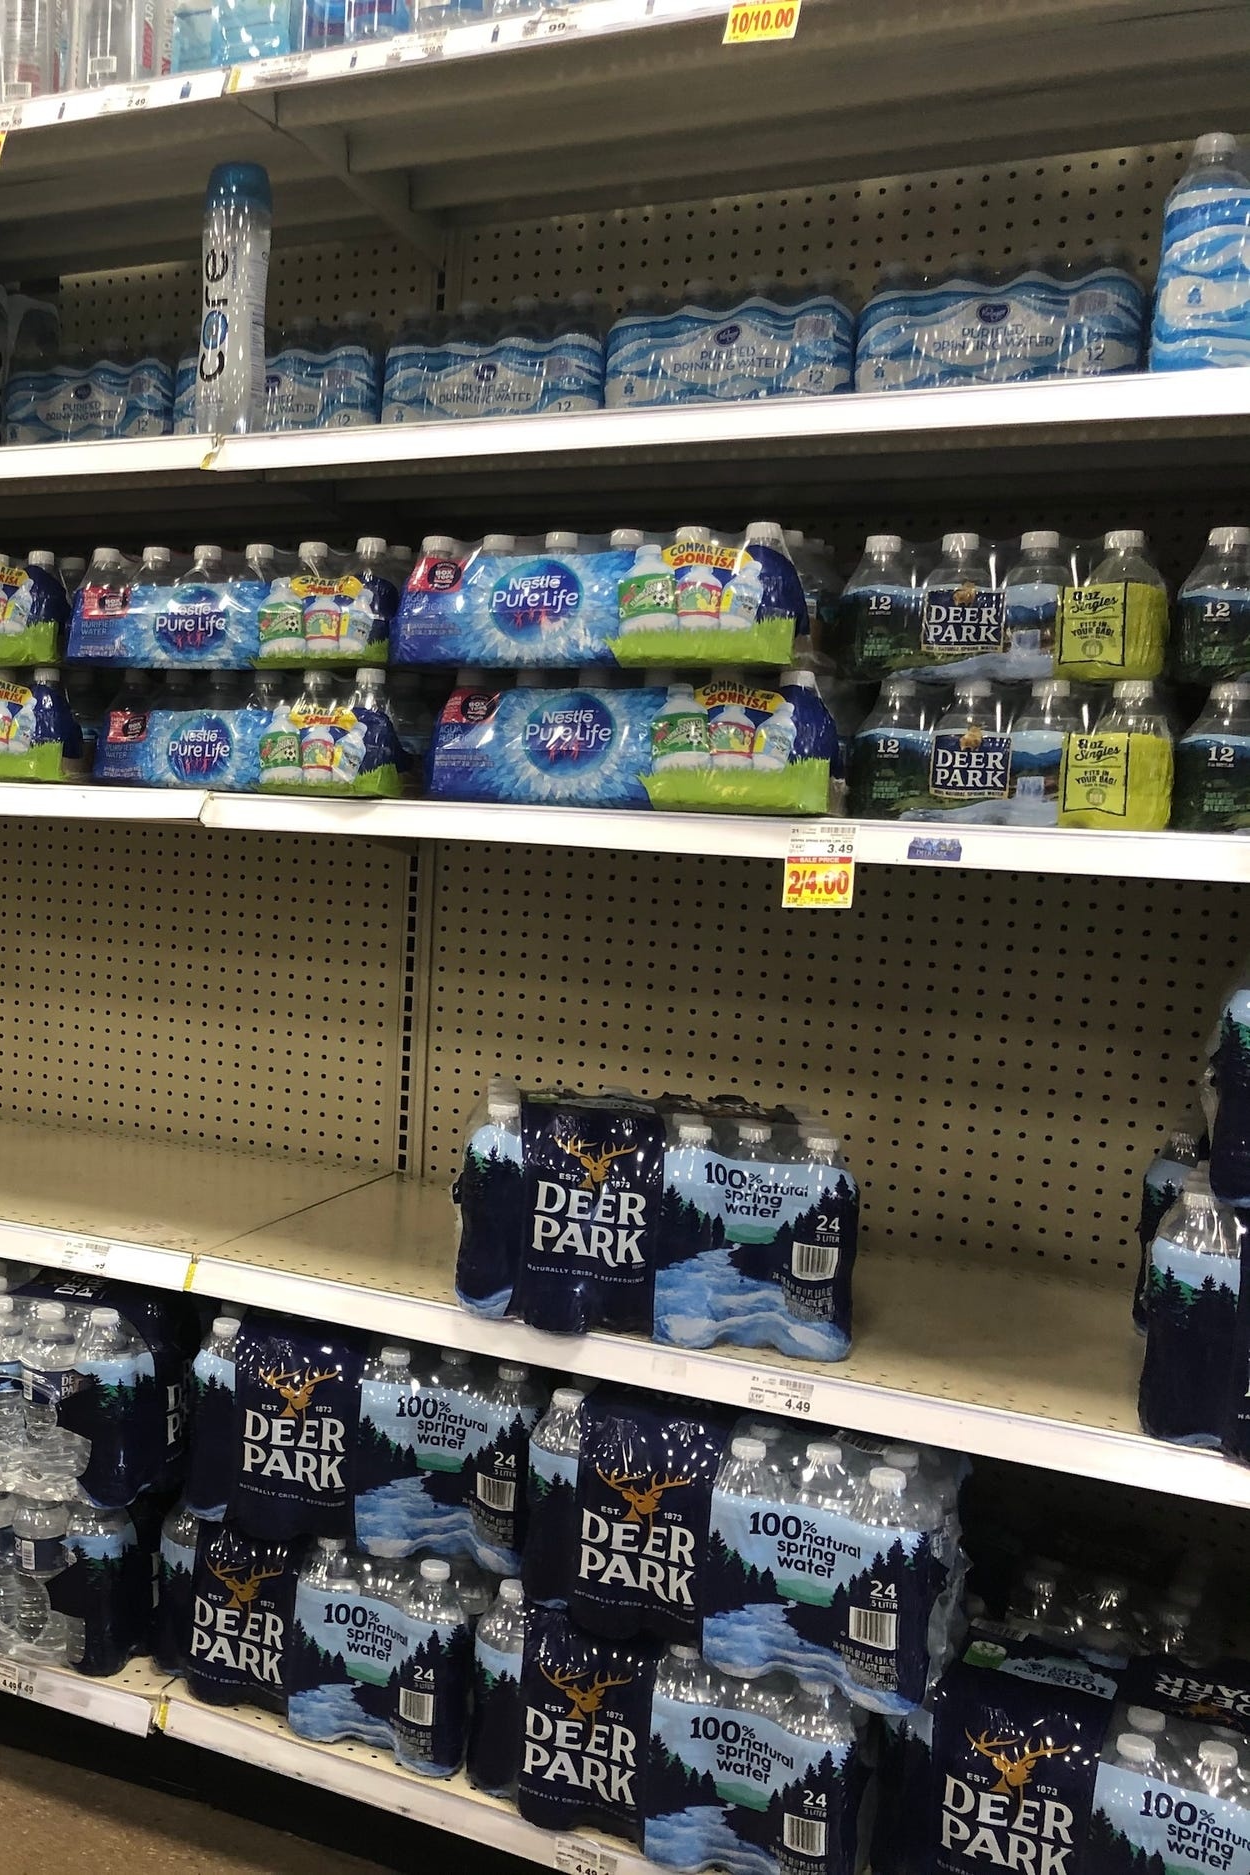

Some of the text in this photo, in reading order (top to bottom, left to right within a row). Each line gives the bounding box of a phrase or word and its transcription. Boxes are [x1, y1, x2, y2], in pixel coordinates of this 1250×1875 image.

[730, 9, 794, 34] 10/10.00
[200, 248, 231, 382] core
[962, 324, 1025, 338] PURIFIED
[932, 335, 1054, 351] DRINKING WATER
[1086, 346, 1105, 361] 12
[699, 347, 757, 361] PURIFIED
[673, 357, 783, 373] DRINKING WATER
[807, 369, 824, 385] 12
[493, 391, 533, 403] WATER
[557, 401, 572, 413] 12
[137, 420, 149, 432] 12
[337, 415, 351, 427] 12
[670, 543, 726, 557] COMPARTE
[672, 553, 735, 568] SONRISA
[492, 589, 579, 613] Pure Life
[869, 595, 892, 610] 12
[1072, 597, 1118, 614] Singles
[1204, 602, 1231, 618] 12
[929, 605, 999, 625] DEER
[1080, 621, 1097, 629] FITS
[155, 616, 226, 637] Pure Life
[927, 625, 999, 643] PARK
[1071, 627, 1094, 637] YOUR
[703, 681, 756, 697] COMPARTE
[705, 693, 768, 710] SONRISA
[525, 724, 612, 748] Pure Life
[877, 739, 899, 753] 12
[169, 742, 230, 763] Pure Life
[935, 748, 1005, 769] DEER
[1075, 747, 1121, 762] Singles
[1208, 746, 1235, 762] 12
[935, 768, 1005, 788] PARK
[1075, 775, 1117, 786] YOUR BAG!
[827, 843, 854, 854] 3.49
[788, 870, 849, 897] 2/4.00
[559, 1173, 579, 1182] EST.
[705, 1162, 762, 1190] 100%
[724, 1187, 783, 1208] spring
[748, 1181, 809, 1199] natural
[534, 1180, 647, 1227] DEER
[726, 1202, 781, 1219] water
[815, 1214, 841, 1232] 24
[532, 1214, 646, 1269] PARK
[823, 1234, 840, 1243] LITER
[527, 1263, 645, 1284] NATURALLY CRISP REFRESHING
[261, 1403, 332, 1414] EST. 1873
[395, 1395, 451, 1420] 100%
[784, 1399, 811, 1413] 4.49
[242, 1408, 347, 1454] DEER
[417, 1419, 466, 1442] spring
[438, 1410, 488, 1434] natural
[417, 1431, 465, 1451] water
[242, 1442, 346, 1492] PARK
[493, 1451, 517, 1468] 24
[239, 1482, 276, 1498] NATURALLY
[306, 1497, 346, 1508] REFRESHING
[601, 1505, 683, 1522] EST. 1873
[750, 1511, 817, 1539] 100%
[581, 1507, 696, 1568] DEER
[802, 1531, 861, 1560] natural
[777, 1538, 836, 1568] spring
[578, 1543, 696, 1605] PARK
[777, 1556, 834, 1580] water
[208, 1592, 224, 1602] EST.
[869, 1580, 896, 1600] 24
[194, 1595, 284, 1650] DEER
[323, 1602, 380, 1628] 100%
[346, 1626, 393, 1652] spring
[367, 1620, 408, 1647] natural
[190, 1626, 283, 1685] PARK
[347, 1640, 392, 1663] water
[413, 1665, 435, 1681] 24
[544, 1703, 624, 1721] EST. 1873
[525, 1705, 637, 1768] DEER
[689, 1715, 756, 1742] 100%
[716, 1741, 772, 1773] spring
[741, 1736, 795, 1770] natural
[522, 1743, 636, 1806] PARK
[717, 1759, 771, 1785] water
[966, 1772, 1058, 1796] EST. 1873
[803, 1790, 827, 1808] 24
[942, 1773, 1076, 1845] DEER
[1139, 1789, 1216, 1827] 100%
[940, 1809, 1074, 1875] PARK
[1167, 1823, 1234, 1861] spring
[1167, 1839, 1232, 1871] water
